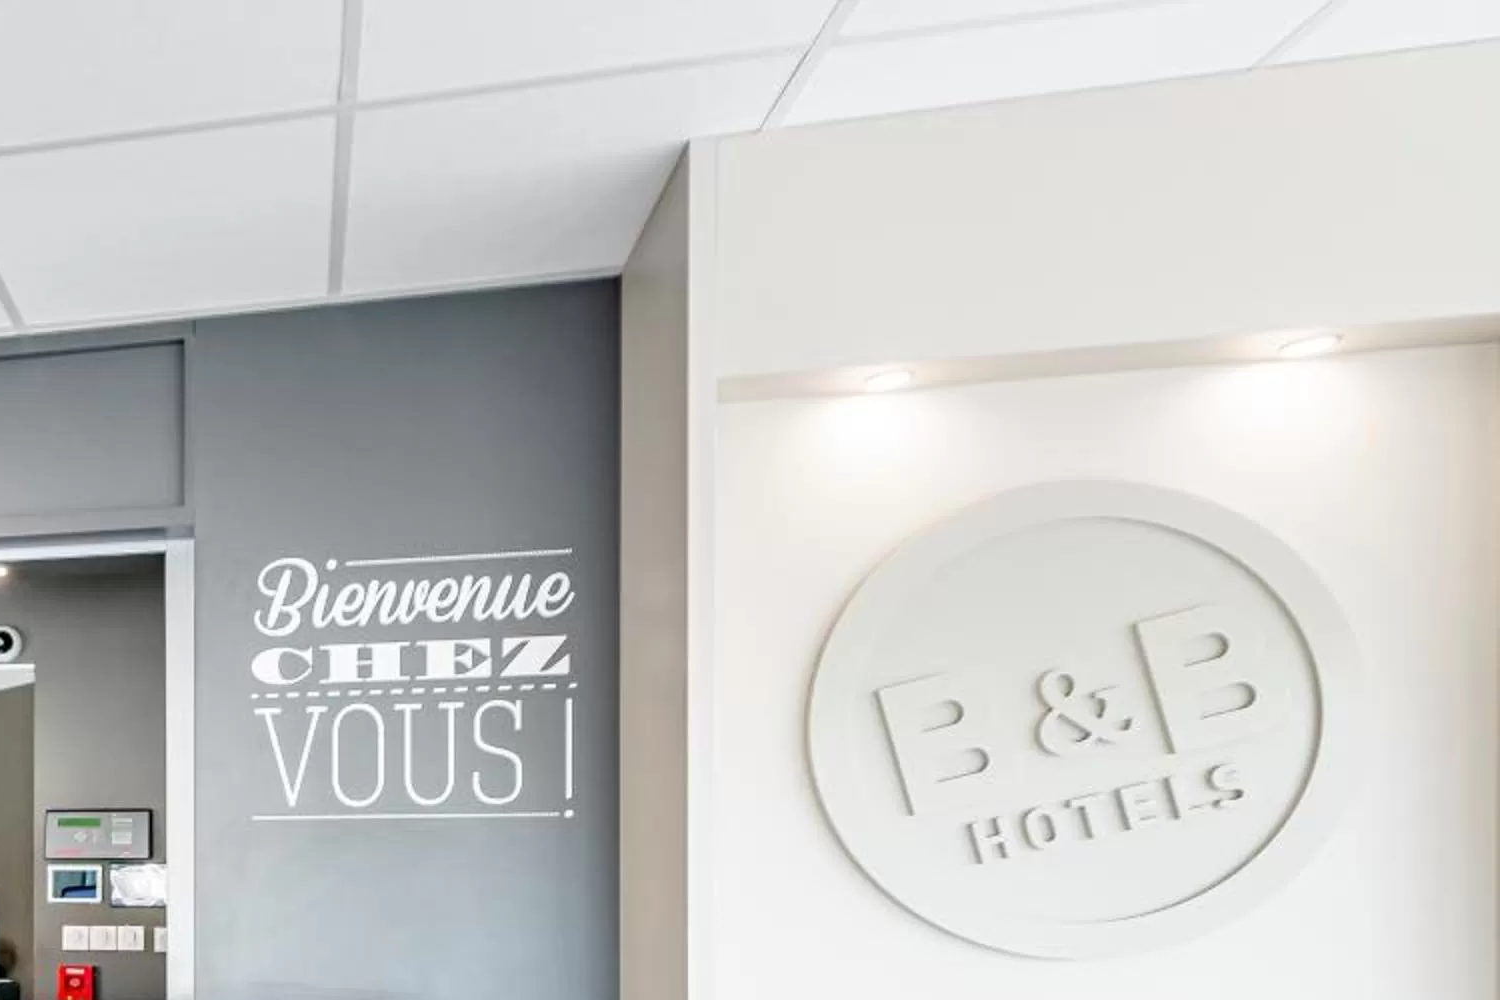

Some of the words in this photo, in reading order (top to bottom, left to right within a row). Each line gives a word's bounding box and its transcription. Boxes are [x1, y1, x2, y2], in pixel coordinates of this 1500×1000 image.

[254, 556, 576, 637] Bienvenue
[251, 634, 571, 686] CHEZ
[966, 763, 1246, 865] HOTELS
